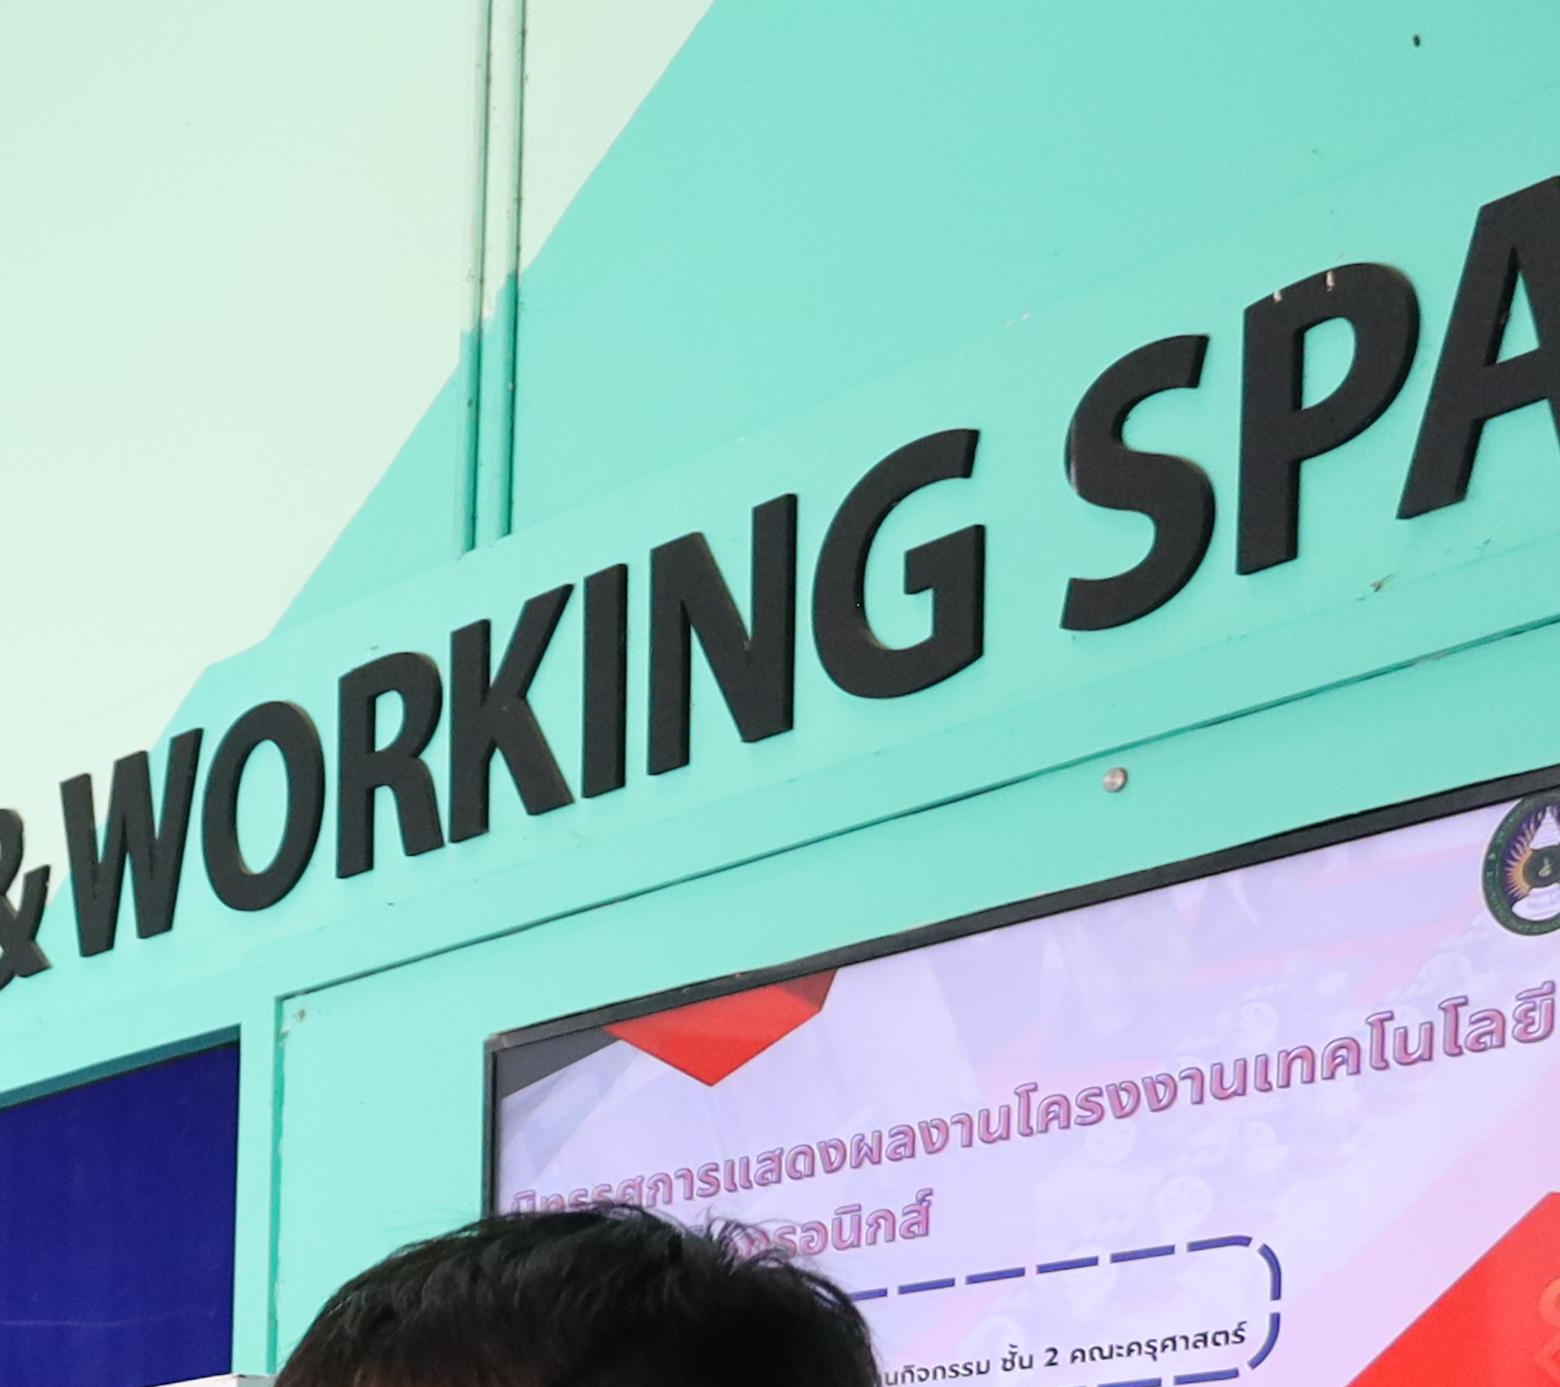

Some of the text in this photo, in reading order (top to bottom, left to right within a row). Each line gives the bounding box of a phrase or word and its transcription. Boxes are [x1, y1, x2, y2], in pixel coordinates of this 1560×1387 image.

[59, 426, 987, 959] WORKING
[881, 1321, 1248, 1387] นกิจกรรม ชั้น 2 คณะครุศาสตร์
